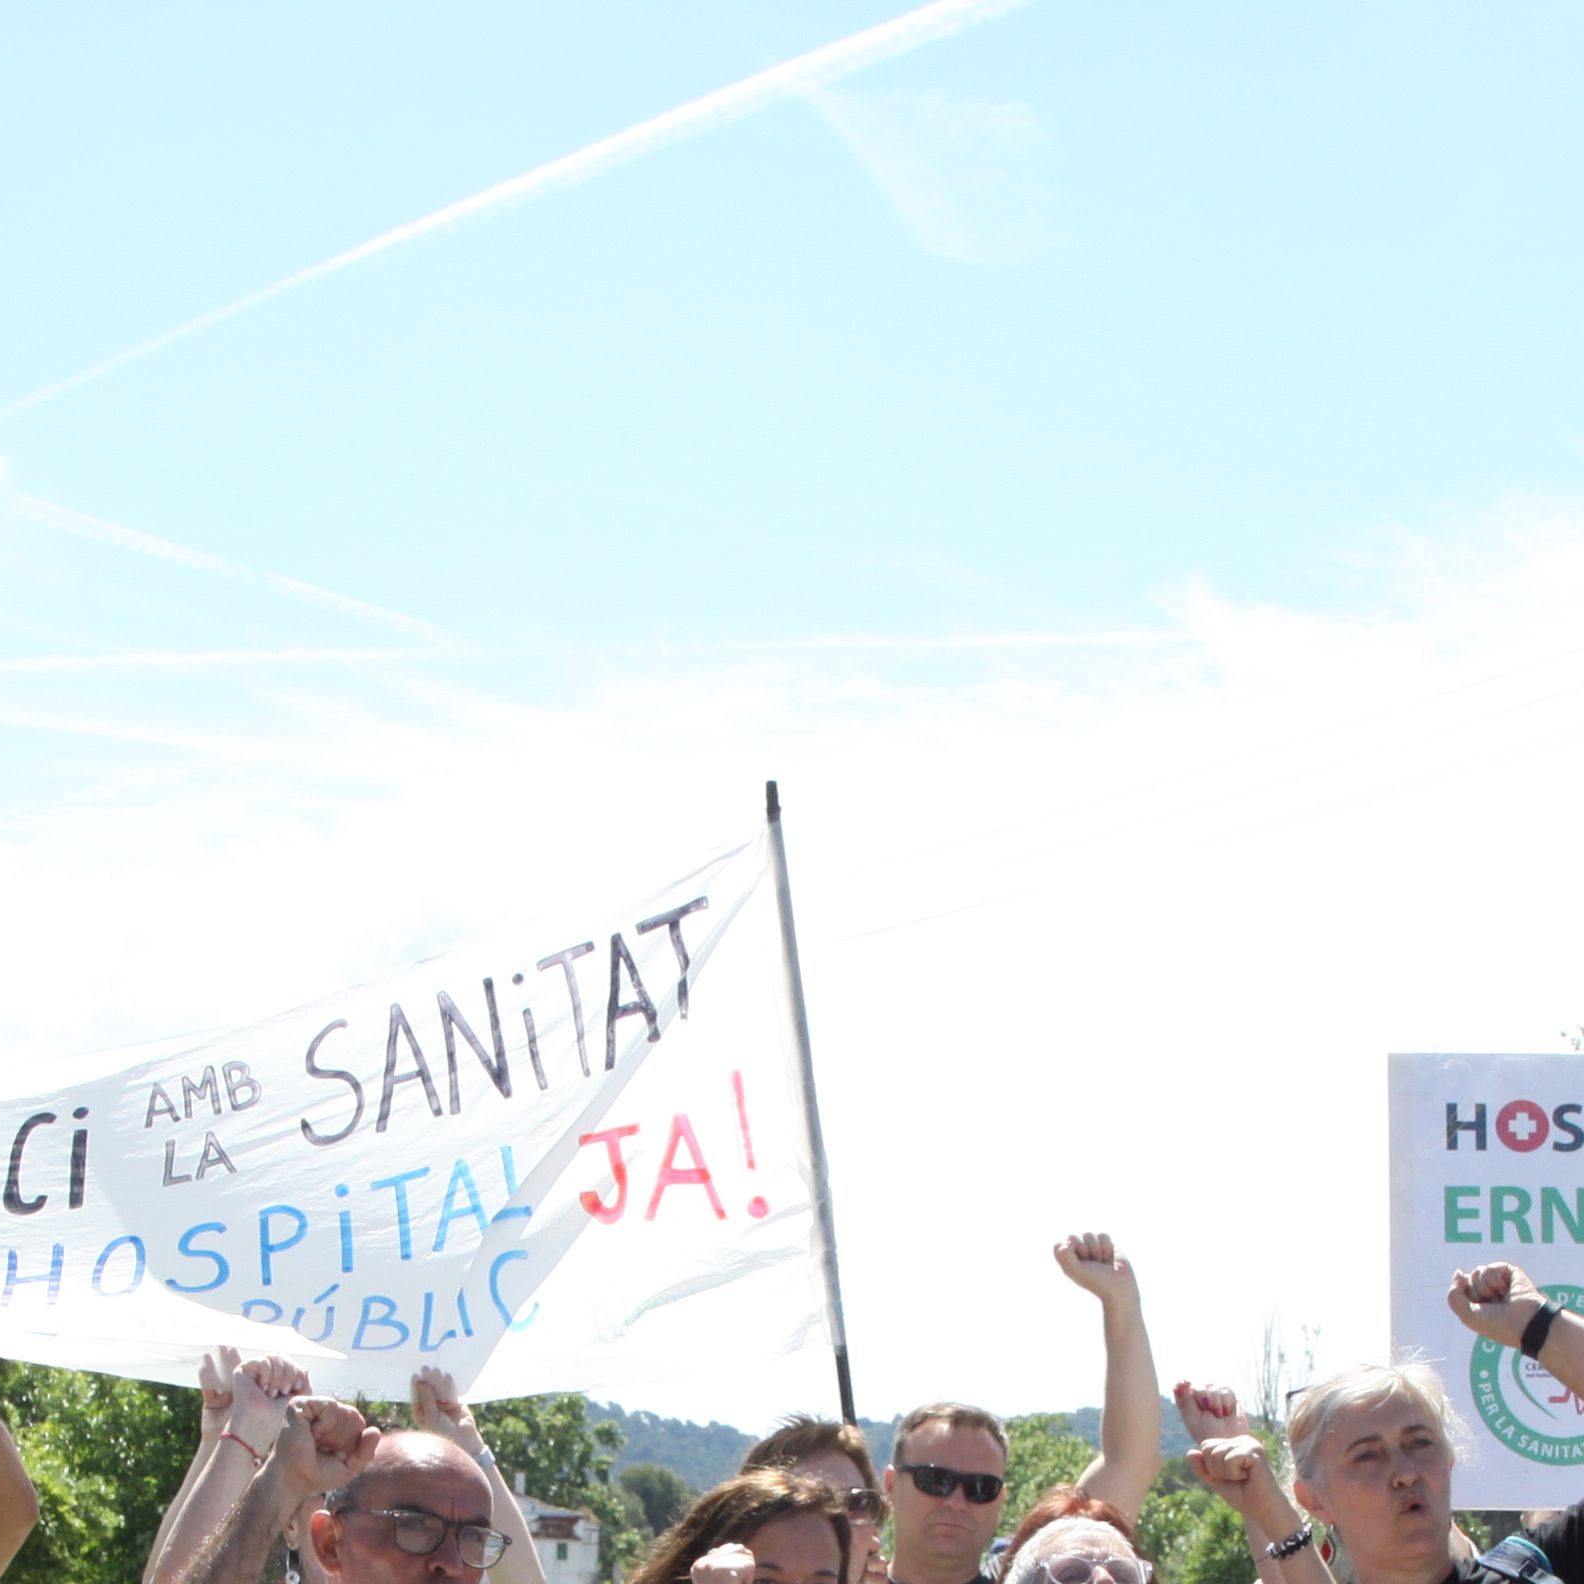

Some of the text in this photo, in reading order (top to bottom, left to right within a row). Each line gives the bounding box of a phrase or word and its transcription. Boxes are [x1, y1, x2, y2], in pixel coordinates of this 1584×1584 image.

[144, 896, 709, 1146] AMB SANiTAT
[163, 1131, 238, 1187] LA
[579, 1069, 771, 1225] JA!
[1478, 1382, 1500, 1415] PER
[1495, 1416, 1514, 1439] LA
